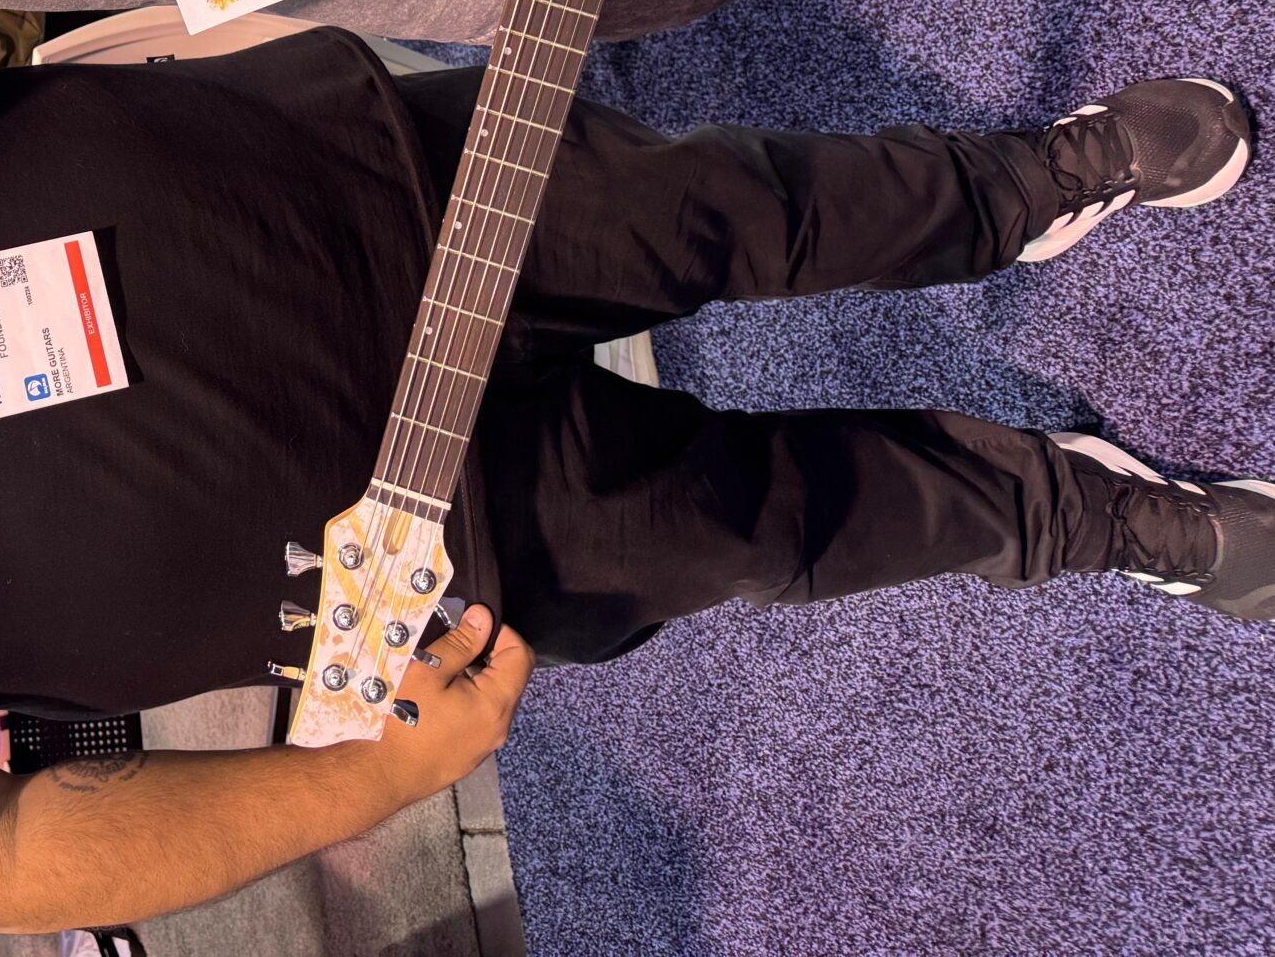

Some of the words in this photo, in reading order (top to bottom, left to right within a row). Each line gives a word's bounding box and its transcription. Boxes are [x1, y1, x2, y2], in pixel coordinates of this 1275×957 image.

[79, 292, 96, 335] EXHIBITOR
[42, 327, 58, 367] GUITARS
[51, 369, 64, 397] MORE
[57, 348, 74, 394] ARGENTINA
